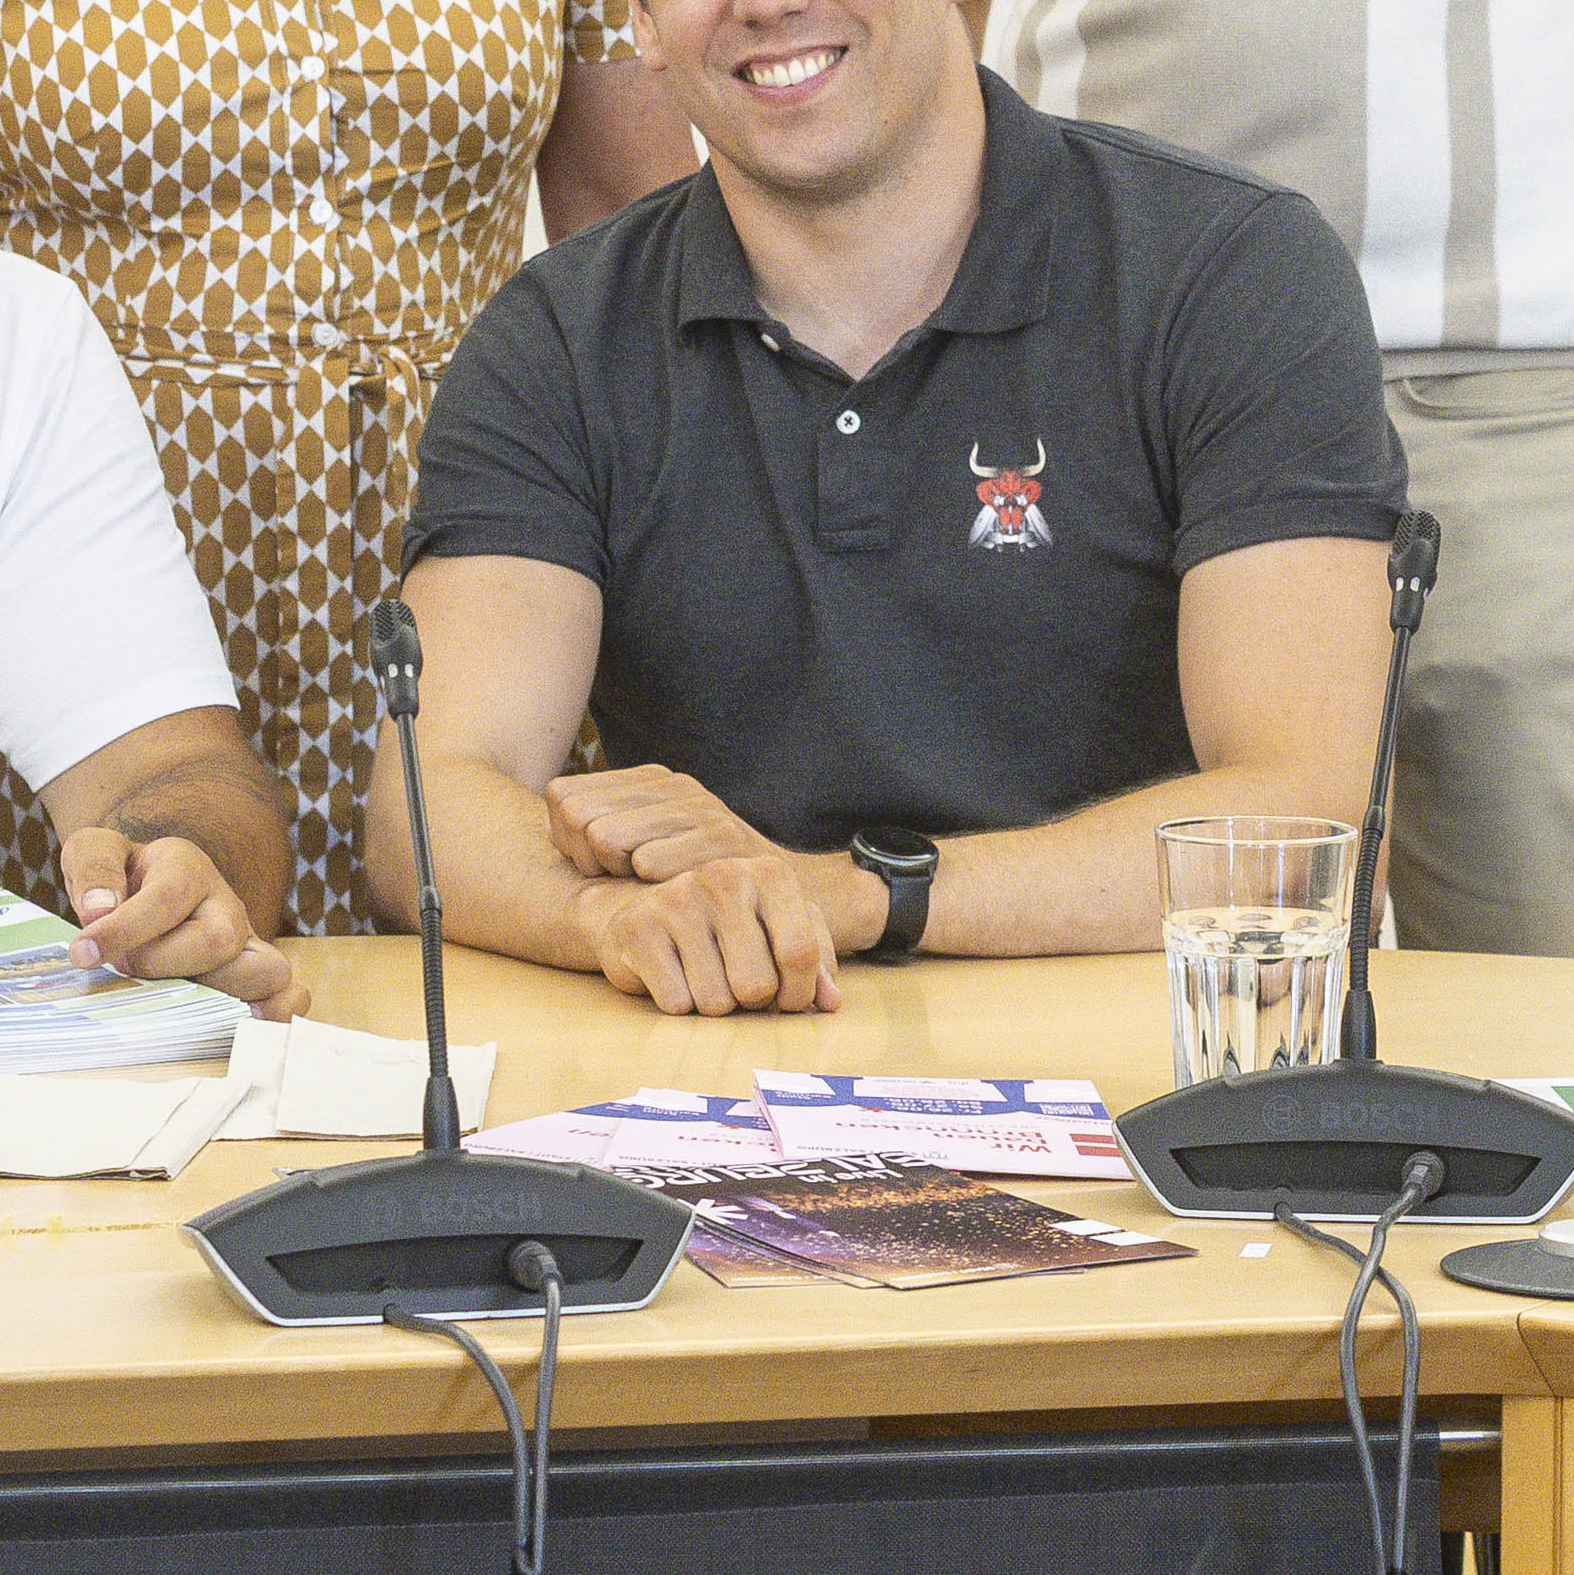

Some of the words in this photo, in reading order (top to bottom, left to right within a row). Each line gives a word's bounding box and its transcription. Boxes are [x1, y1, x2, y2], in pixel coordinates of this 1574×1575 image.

[1319, 1100, 1440, 1133] BOSCH
[992, 1143, 1052, 1154] Wir
[419, 1190, 542, 1224] BOSCH
